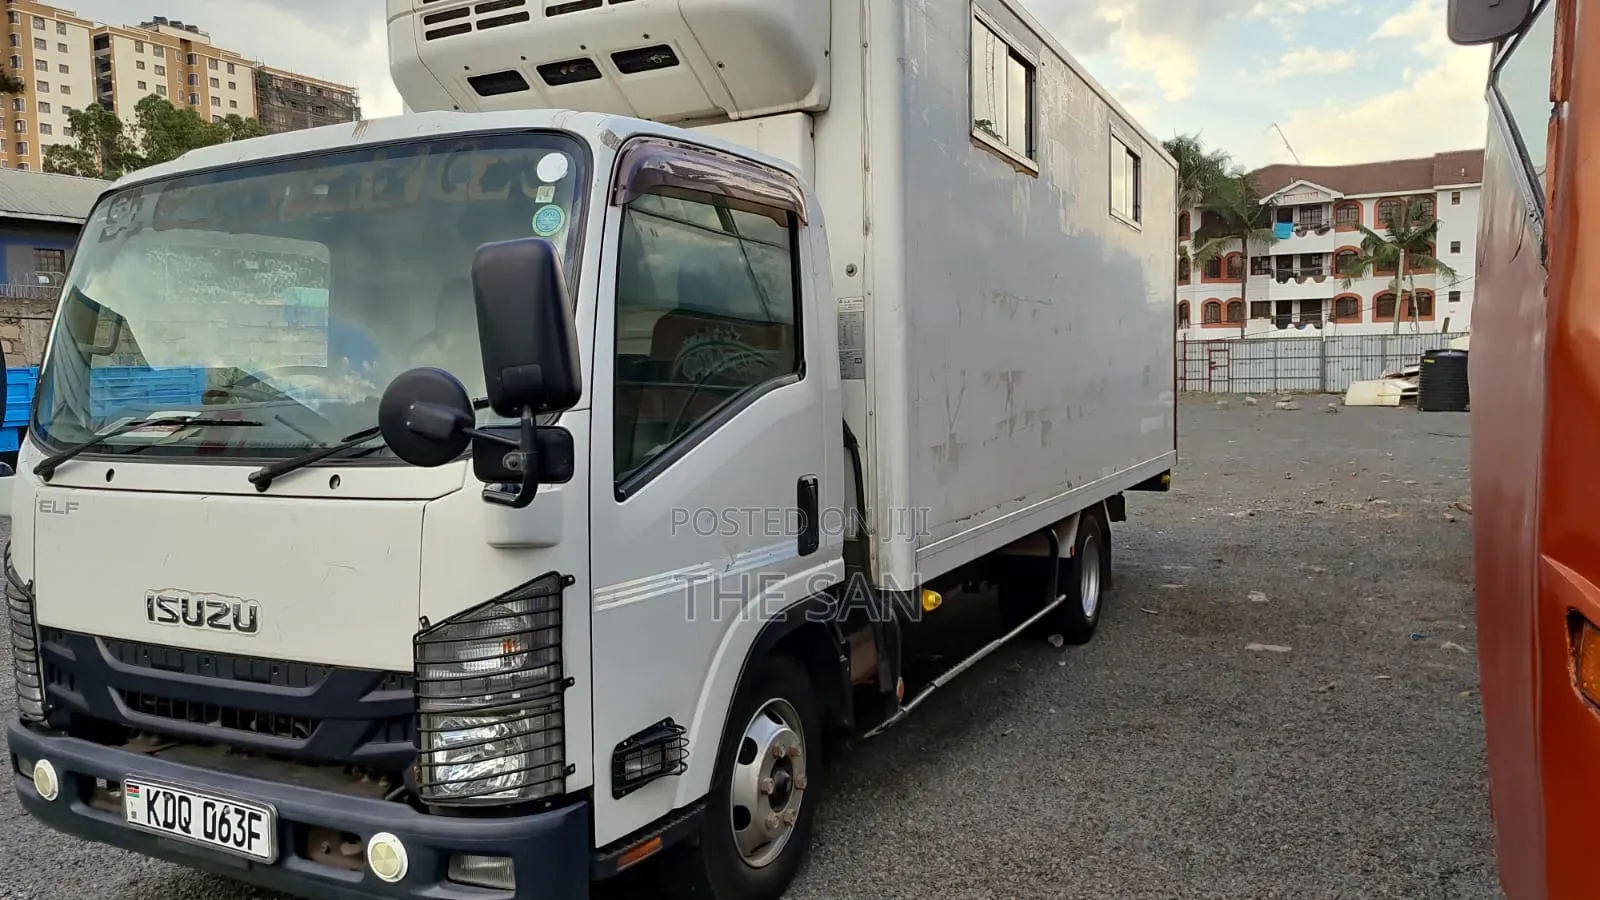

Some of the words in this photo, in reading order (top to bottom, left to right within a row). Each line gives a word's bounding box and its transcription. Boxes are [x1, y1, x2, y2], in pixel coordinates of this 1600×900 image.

[39, 500, 79, 515] ELF
[146, 595, 258, 633] ISUZU
[146, 788, 192, 834] KDQ
[203, 801, 262, 850] 063F
